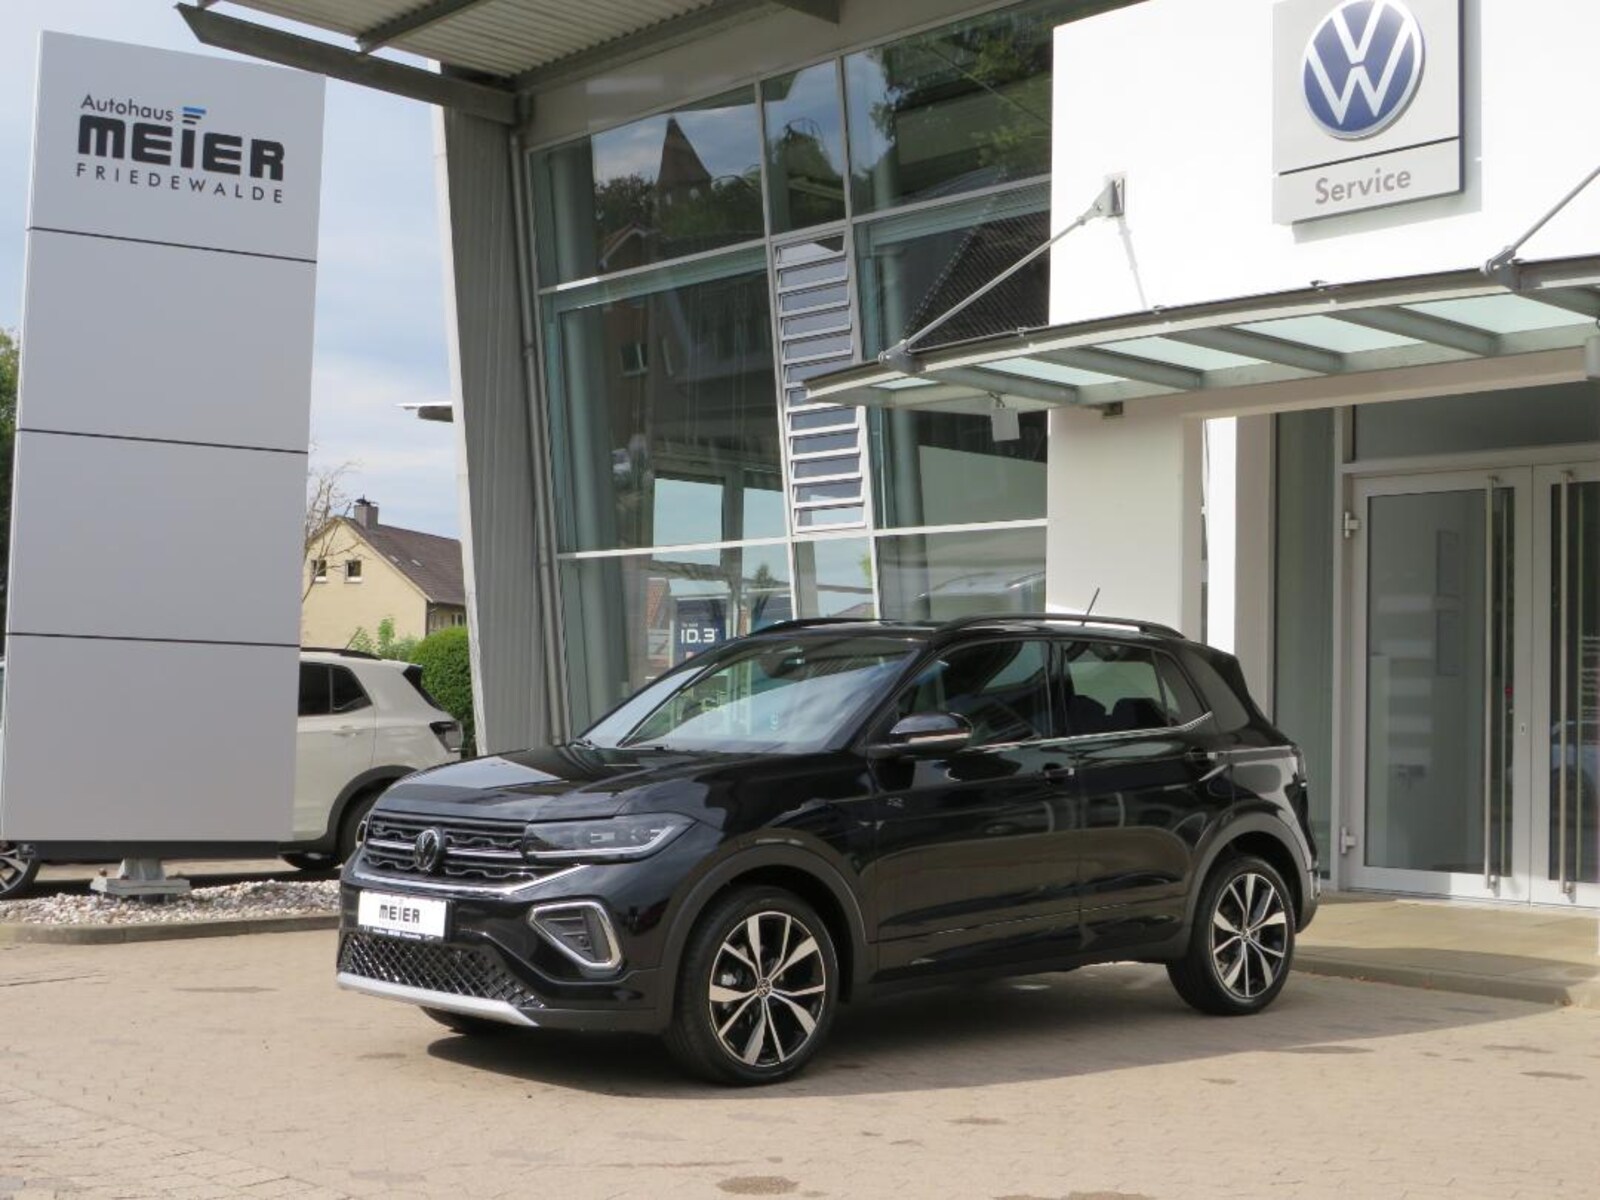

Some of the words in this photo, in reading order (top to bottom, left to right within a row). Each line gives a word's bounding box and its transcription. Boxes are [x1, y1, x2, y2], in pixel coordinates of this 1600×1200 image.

[80, 94, 174, 122] Autohaus
[78, 112, 285, 181] MEIER
[76, 162, 283, 204] FRIEDEWALDE
[1314, 167, 1411, 205] Service
[379, 904, 420, 924] MEIER
